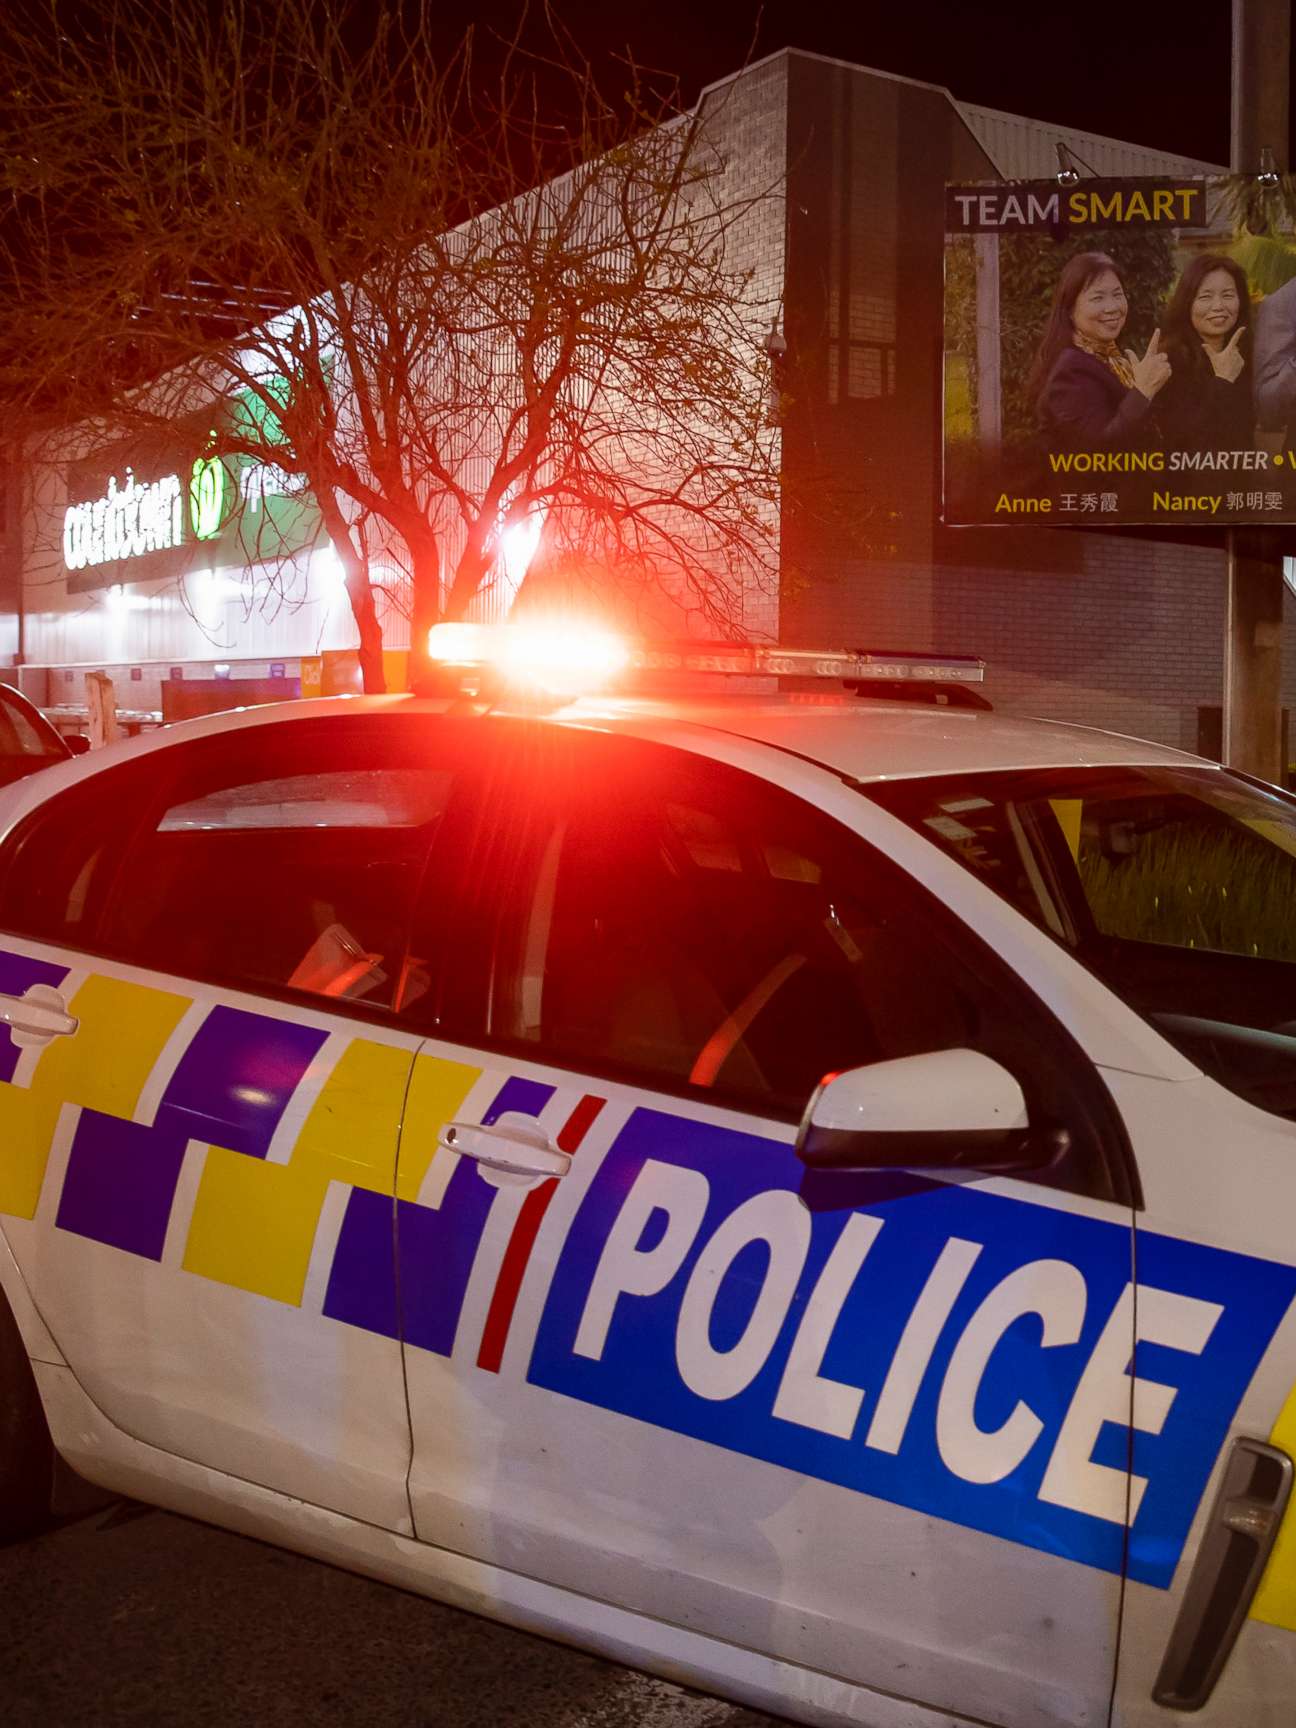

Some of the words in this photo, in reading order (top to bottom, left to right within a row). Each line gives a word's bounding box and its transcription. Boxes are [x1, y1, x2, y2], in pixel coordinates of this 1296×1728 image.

[954, 194, 1059, 226] TEAM
[1068, 189, 1198, 224] SMART
[1049, 453, 1165, 473] WORKING
[1168, 451, 1268, 471] SMARTER
[995, 494, 1052, 513] Anne
[1058, 493, 1119, 513] 王秀霞
[1152, 492, 1222, 514] Nancy
[1225, 491, 1284, 511] 郭明雯
[573, 1158, 1225, 1527] POLICE
